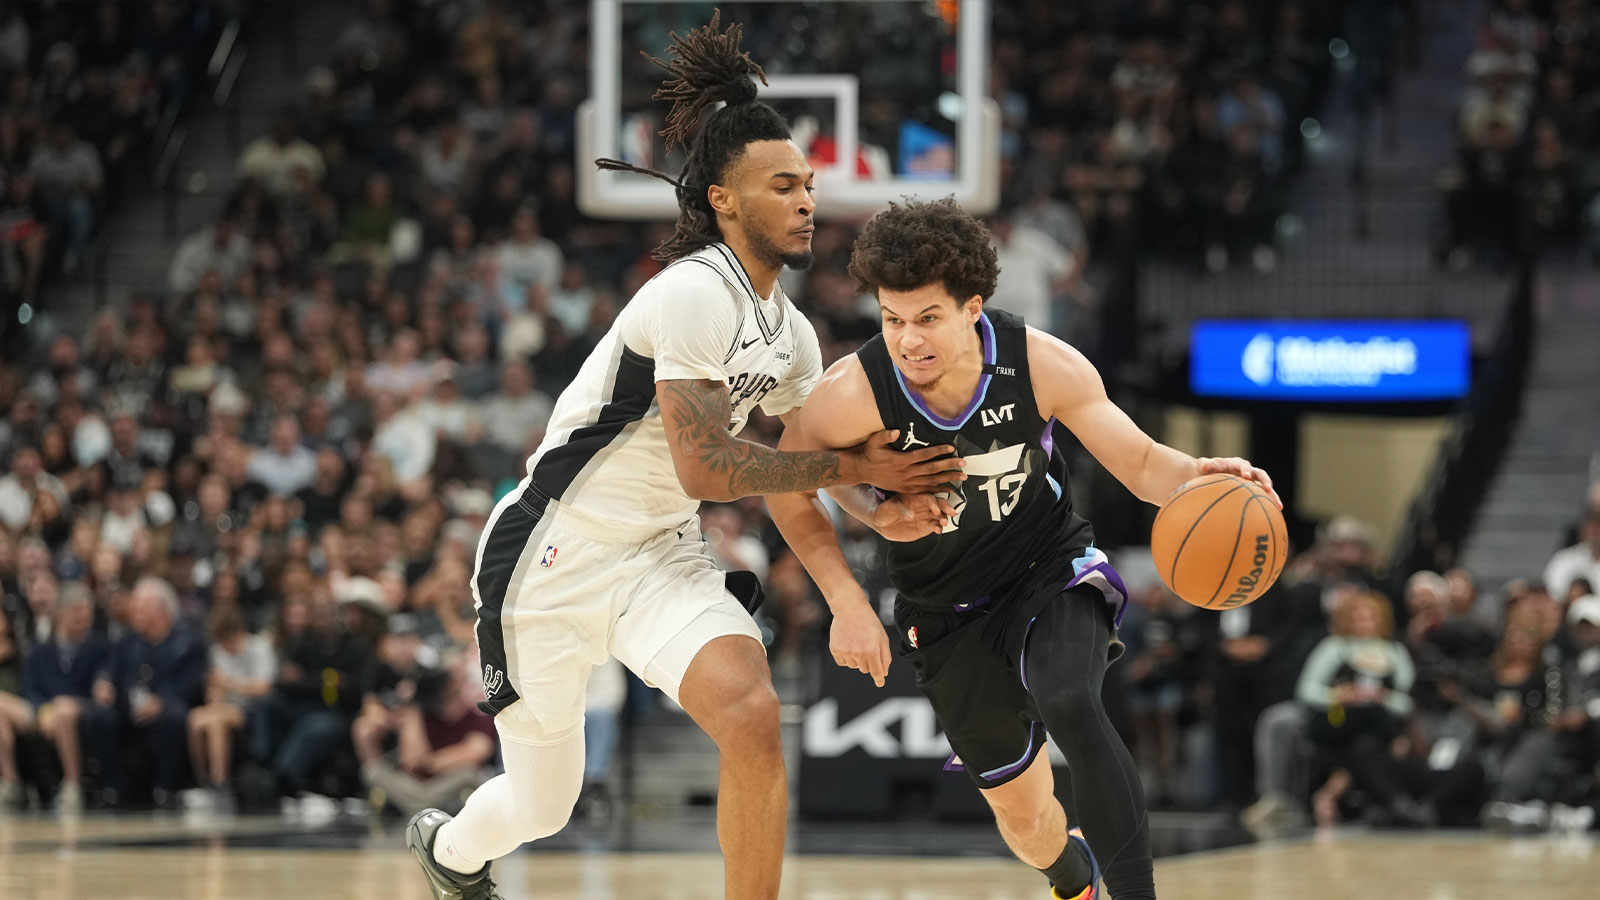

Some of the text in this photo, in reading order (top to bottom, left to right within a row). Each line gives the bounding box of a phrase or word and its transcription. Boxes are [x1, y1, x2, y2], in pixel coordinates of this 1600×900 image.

[996, 366, 1016, 376] FRANK
[728, 372, 779, 412] PUR
[981, 403, 1015, 427] LVT
[978, 472, 1027, 522] 13
[1219, 533, 1269, 607] Wilson
